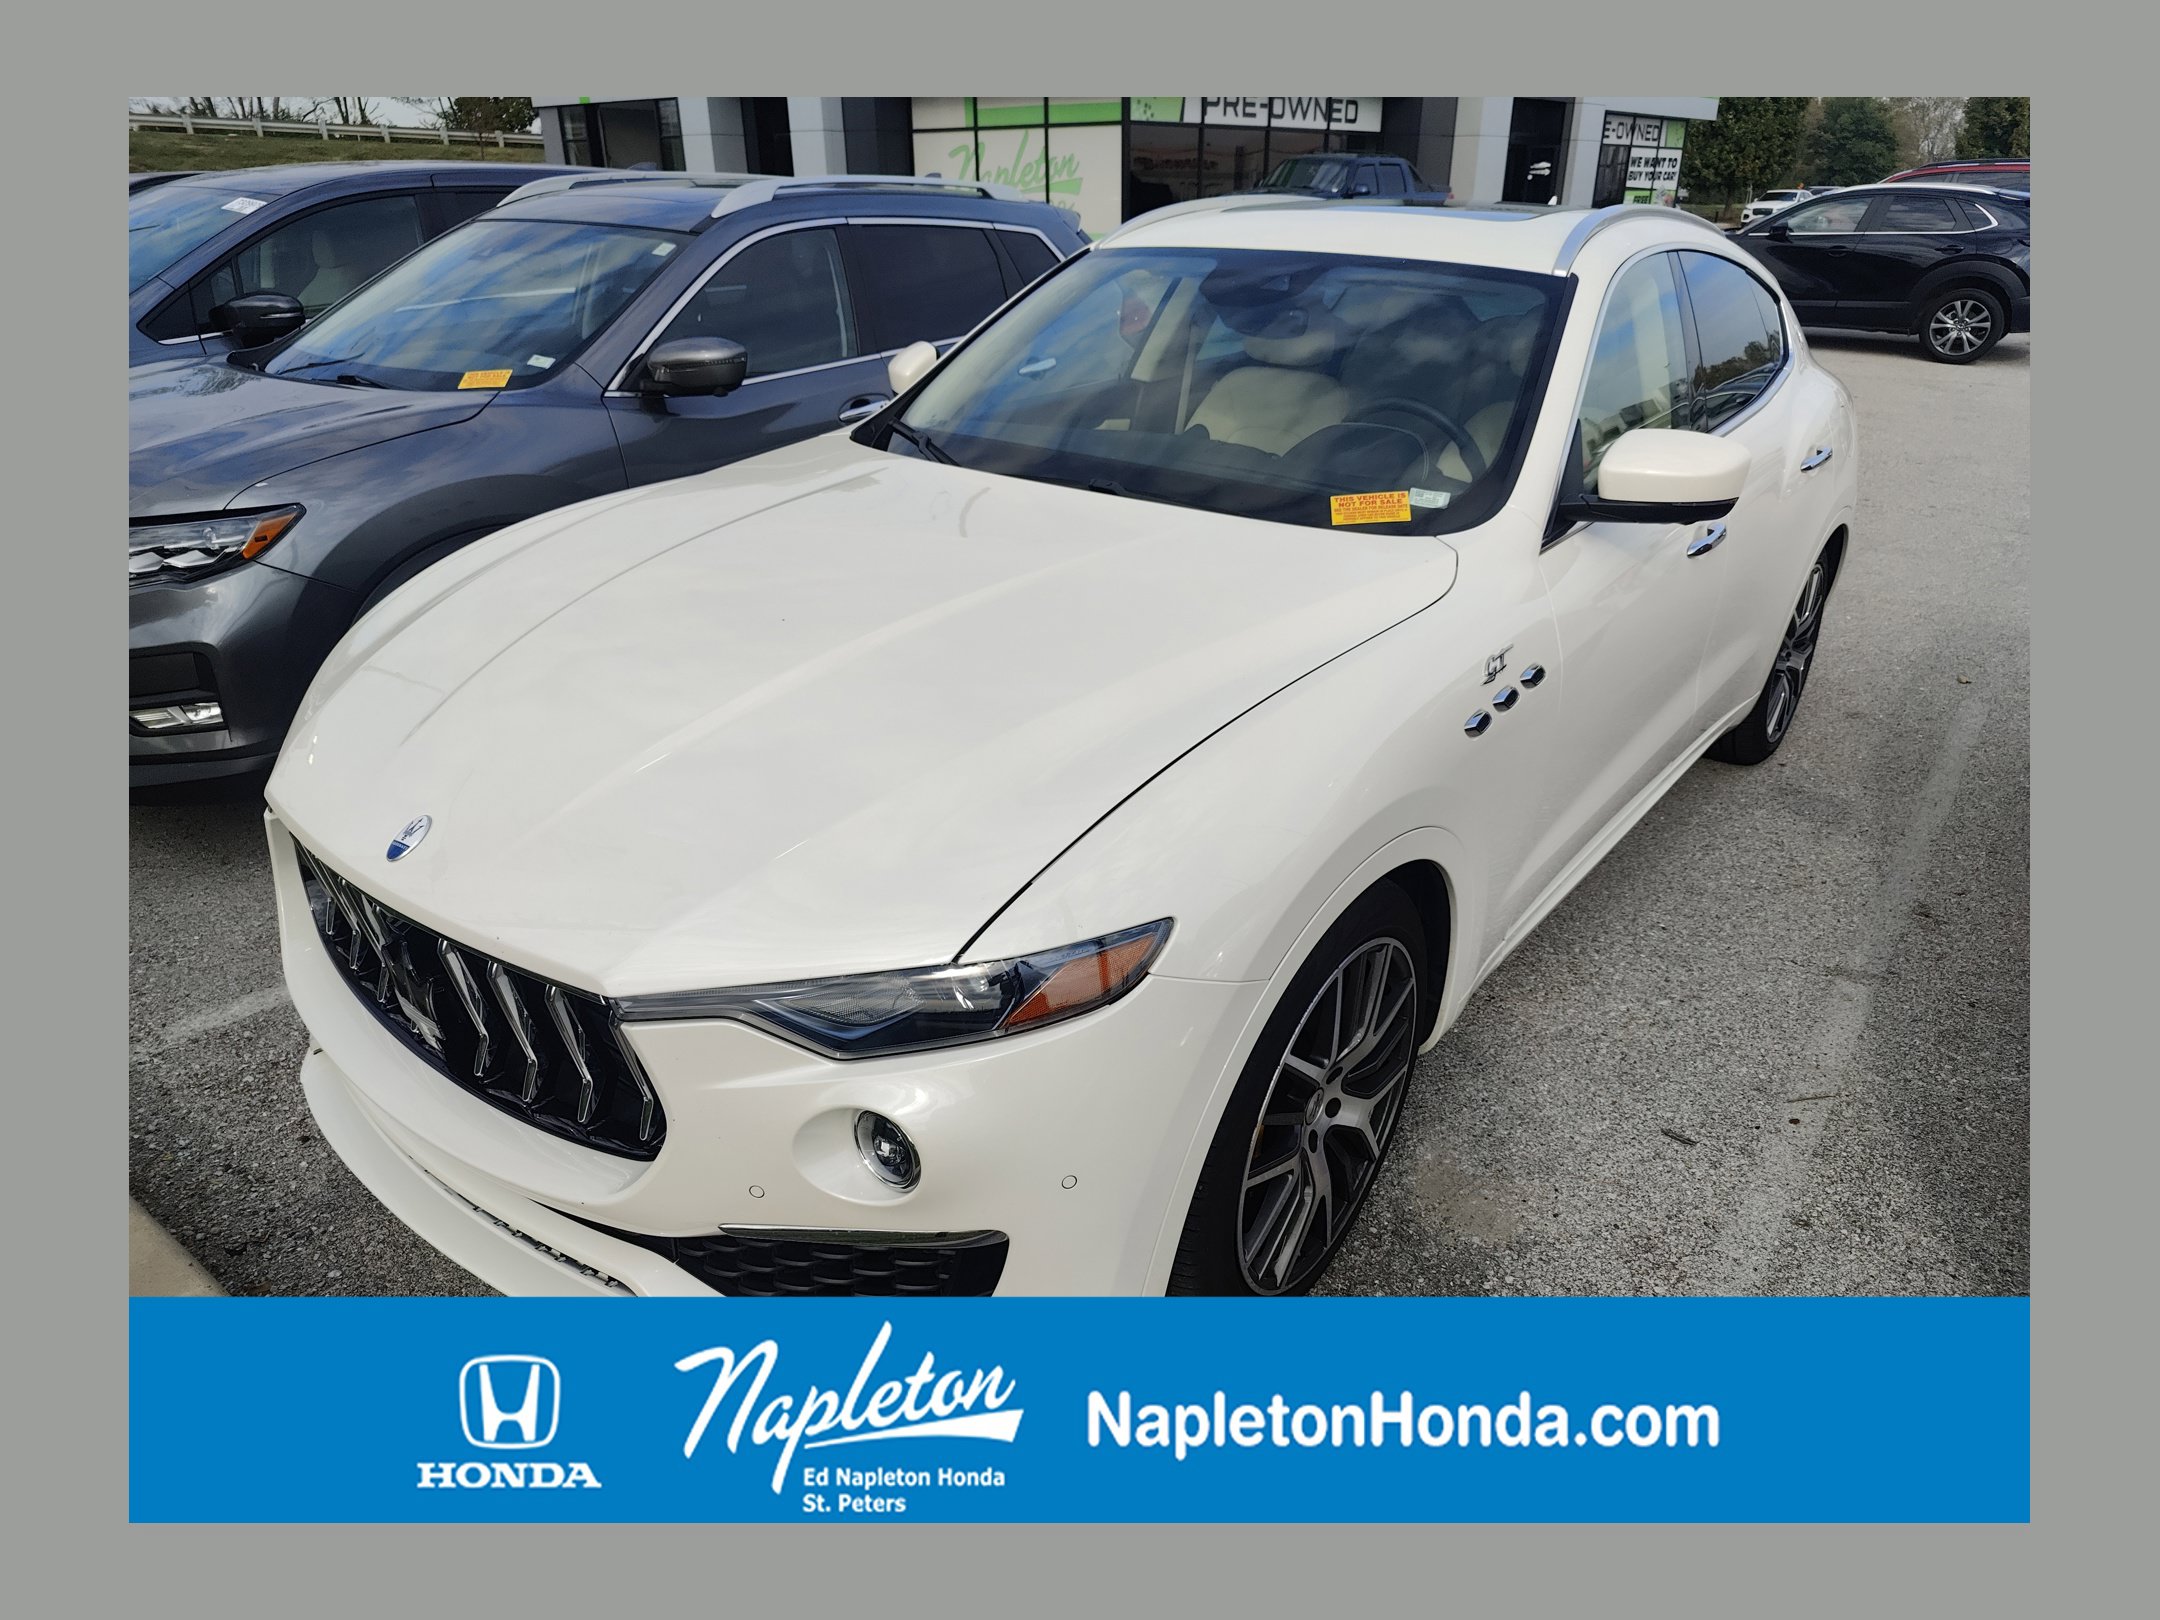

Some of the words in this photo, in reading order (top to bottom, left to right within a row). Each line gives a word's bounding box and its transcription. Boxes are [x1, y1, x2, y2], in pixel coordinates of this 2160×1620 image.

[1202, 97, 1359, 124] PRE-OWNED
[1630, 157, 1643, 168] WE
[1643, 157, 1667, 168] WANT
[1667, 157, 1678, 169] TO
[1628, 171, 1643, 181] BUY
[1644, 171, 1662, 181] YOUR
[1356, 493, 1394, 501] VEHICLE
